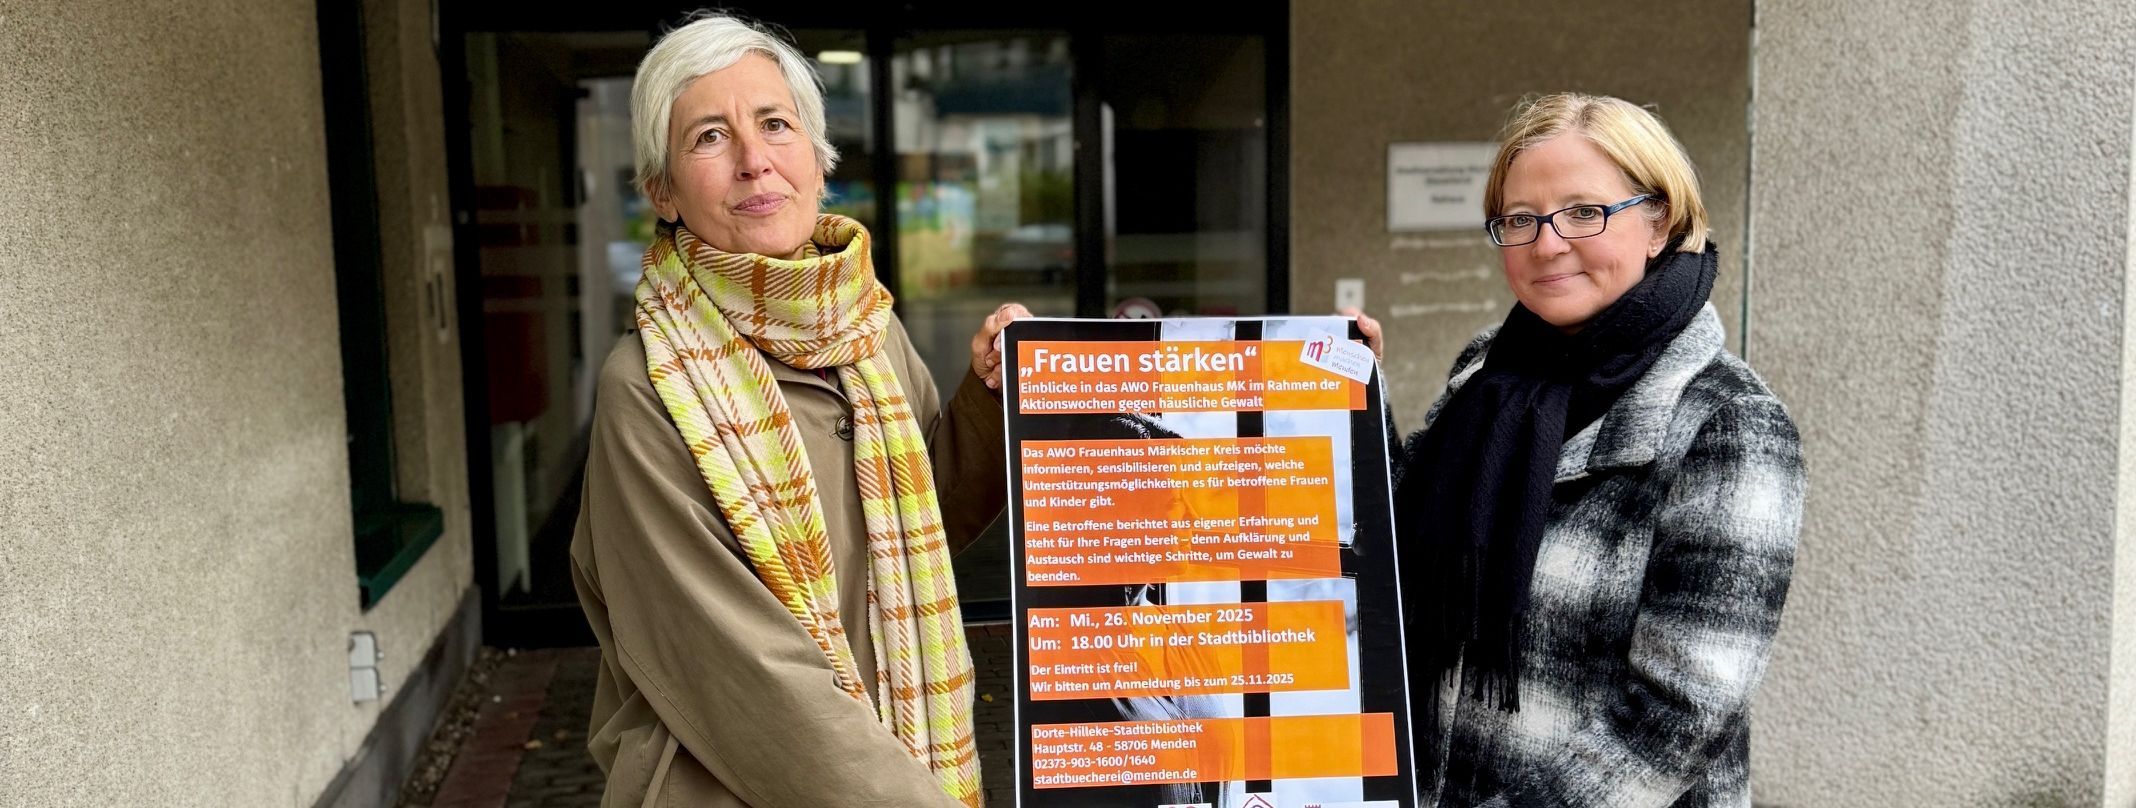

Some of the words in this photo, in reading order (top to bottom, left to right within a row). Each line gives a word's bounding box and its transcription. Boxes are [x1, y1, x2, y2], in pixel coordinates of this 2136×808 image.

[1020, 381, 1078, 393] Einblicke
[1080, 381, 1092, 393] in
[1095, 381, 1118, 393] das
[1120, 381, 1149, 393] AWO
[1152, 381, 1224, 392] Frauenhaus
[1226, 381, 1246, 391] MK
[1249, 380, 1264, 391] im
[1267, 380, 1317, 391] Rahmen
[1320, 379, 1341, 390] der
[1020, 398, 1115, 410] Aktionswochen
[1118, 399, 1156, 411] gegen
[1159, 396, 1218, 409] häusliche
[1221, 396, 1263, 408] Gewalt
[1022, 448, 1044, 460] Das
[1047, 447, 1076, 458] AWO
[1079, 446, 1145, 457] Frauenhaus
[1148, 445, 1210, 456] Märkischer
[1214, 444, 1241, 455] Kreis
[1244, 444, 1286, 454] möchte
[1022, 463, 1093, 475] informieren,
[1097, 462, 1177, 473] sensibilisieren
[1180, 461, 1202, 472] und
[1205, 461, 1261, 473] aufzeigen,
[1264, 459, 1304, 470] welche
[1024, 478, 1189, 492] Unterstützungsmöglichkeiten
[1207, 477, 1224, 487] für
[1227, 476, 1287, 487] betroffene
[1290, 476, 1328, 485] Frauen
[1024, 497, 1046, 509] und
[1049, 496, 1086, 507] Kinder
[1089, 496, 1115, 509] gibt.
[1026, 520, 1050, 532] Eine
[1053, 520, 1113, 531] Betroffene
[1116, 519, 1168, 530] berichtet
[1171, 520, 1191, 528] aus
[1194, 518, 1235, 530] eigener
[1239, 516, 1294, 528] Erfahrung
[1297, 515, 1319, 525] und
[1026, 536, 1055, 548] steht
[1057, 537, 1074, 548] für
[1077, 537, 1100, 547] Ihre
[1103, 537, 1141, 548] Fragen
[1144, 535, 1178, 546] bereit
[1191, 534, 1220, 544] denn
[1223, 532, 1285, 544] Aufklärung
[1289, 531, 1310, 542] und
[1027, 553, 1084, 565] Austausch
[1088, 553, 1111, 564] sind
[1114, 552, 1162, 564] wichtige
[1165, 551, 1212, 562] Schritte,
[1216, 552, 1234, 560] um
[1237, 548, 1278, 559] Gewalt
[1281, 550, 1293, 558] zu
[1027, 570, 1080, 583] beenden.
[1028, 613, 1059, 629] Am:
[1070, 613, 1099, 629] Mi.,
[1104, 613, 1127, 626] 26.
[1132, 610, 1212, 625] November
[1217, 608, 1253, 622] 2025
[1029, 635, 1061, 652] Um:
[1071, 635, 1113, 650] 18.00
[1117, 634, 1145, 648] Uhr
[1150, 634, 1163, 646] in
[1168, 633, 1194, 646] der
[1198, 628, 1315, 645] Stadtbibliothek
[1030, 664, 1051, 677] Der
[1054, 664, 1094, 675] Eintritt
[1097, 663, 1110, 673] ist
[1113, 662, 1137, 673] frei!
[1030, 679, 1052, 693] Wir
[1055, 681, 1089, 692] bitten
[1092, 681, 1111, 690] um
[1114, 678, 1181, 690] Anmeldung
[1184, 677, 1201, 687] bis
[1204, 678, 1227, 686] zum
[1231, 673, 1294, 685] 25.11.2025
[1033, 722, 1203, 739] Dorte-Hilleke-Stadtbibliothek
[1034, 742, 1086, 756] Hauptstr.
[1089, 741, 1103, 752] 48
[1114, 740, 1148, 751] 58706
[1151, 738, 1196, 749] Menden
[1034, 754, 1155, 768] 02373-903-1600/1640
[1034, 768, 1197, 785] stadtbuecherei@menden.de
